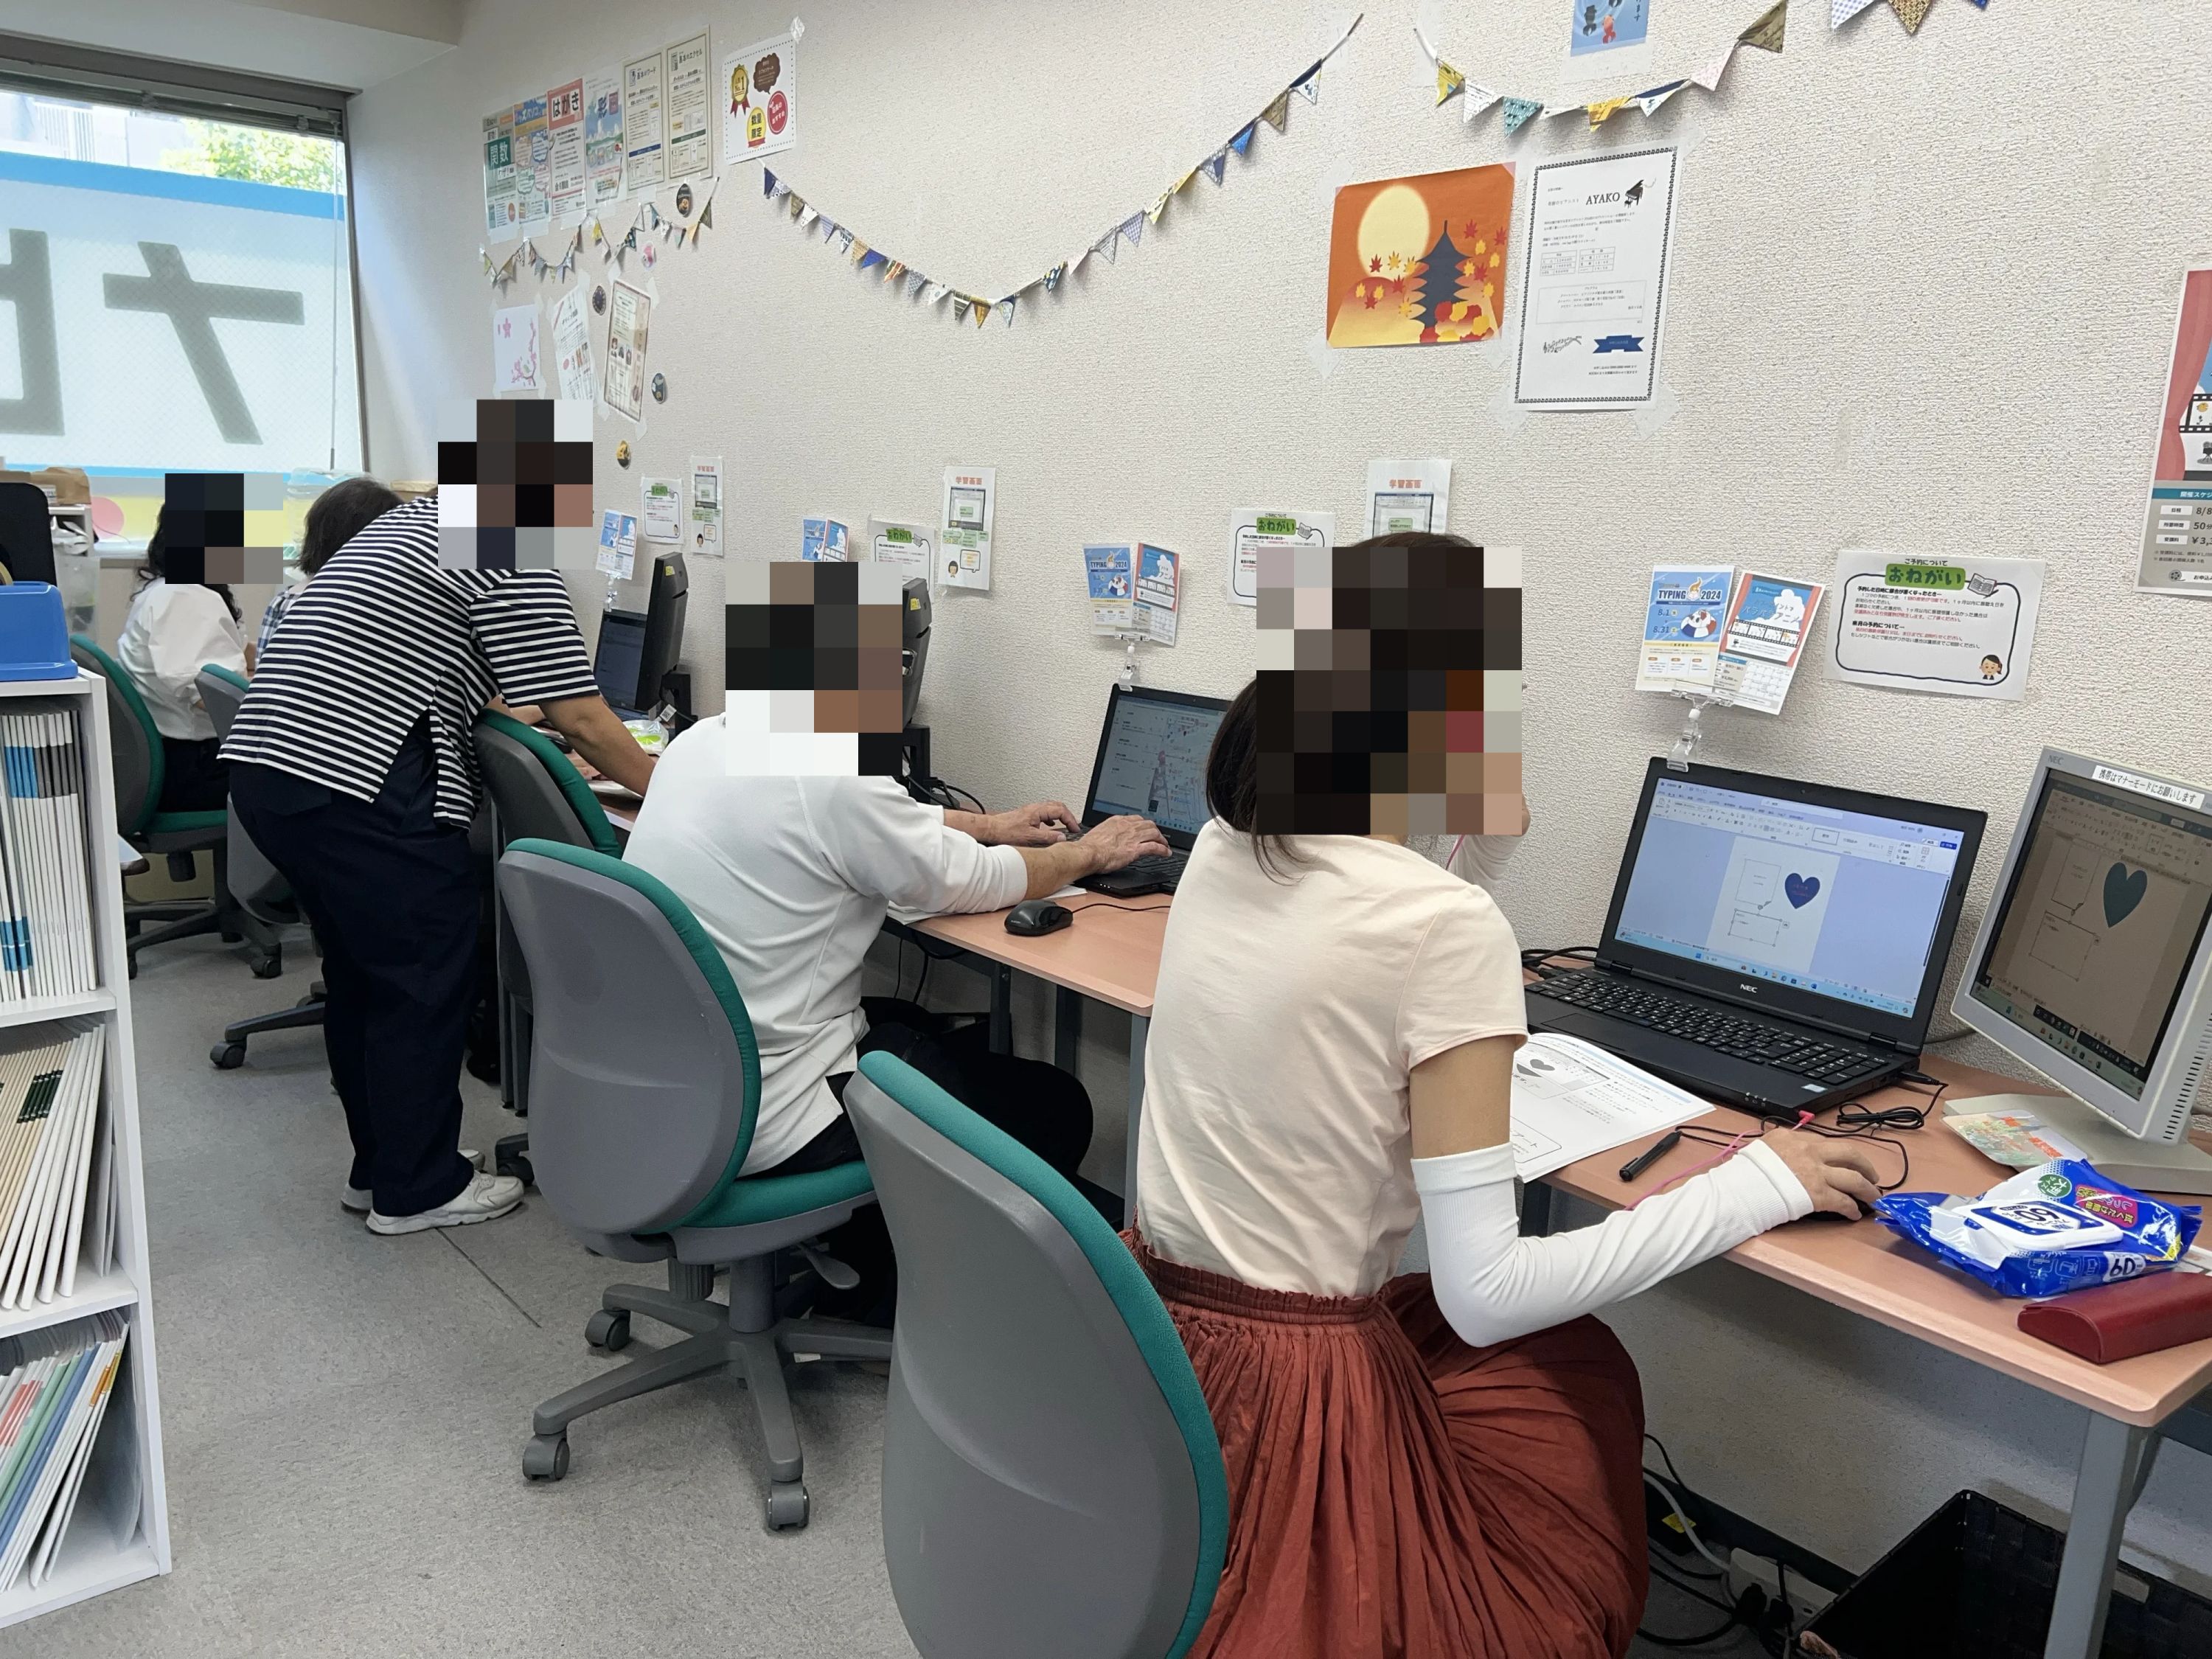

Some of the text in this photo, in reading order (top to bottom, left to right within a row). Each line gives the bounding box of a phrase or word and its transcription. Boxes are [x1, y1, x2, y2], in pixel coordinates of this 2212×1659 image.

[553, 91, 579, 118] はがき
[1585, 192, 1621, 206] AYAKO
[1259, 519, 1295, 532] おねがい
[1905, 557, 1948, 566] ご予約について
[1888, 566, 1962, 585] おねがい
[1658, 590, 1721, 600] TYPING 2024
[1658, 608, 1670, 616] 8.1
[1652, 625, 1671, 633] 8.31
[2048, 754, 2065, 765] NEC
[2099, 769, 2197, 805] 携帯はマナーモードにお願いします
[1739, 983, 1758, 993] NEC
[2014, 1207, 2060, 1222] 60
